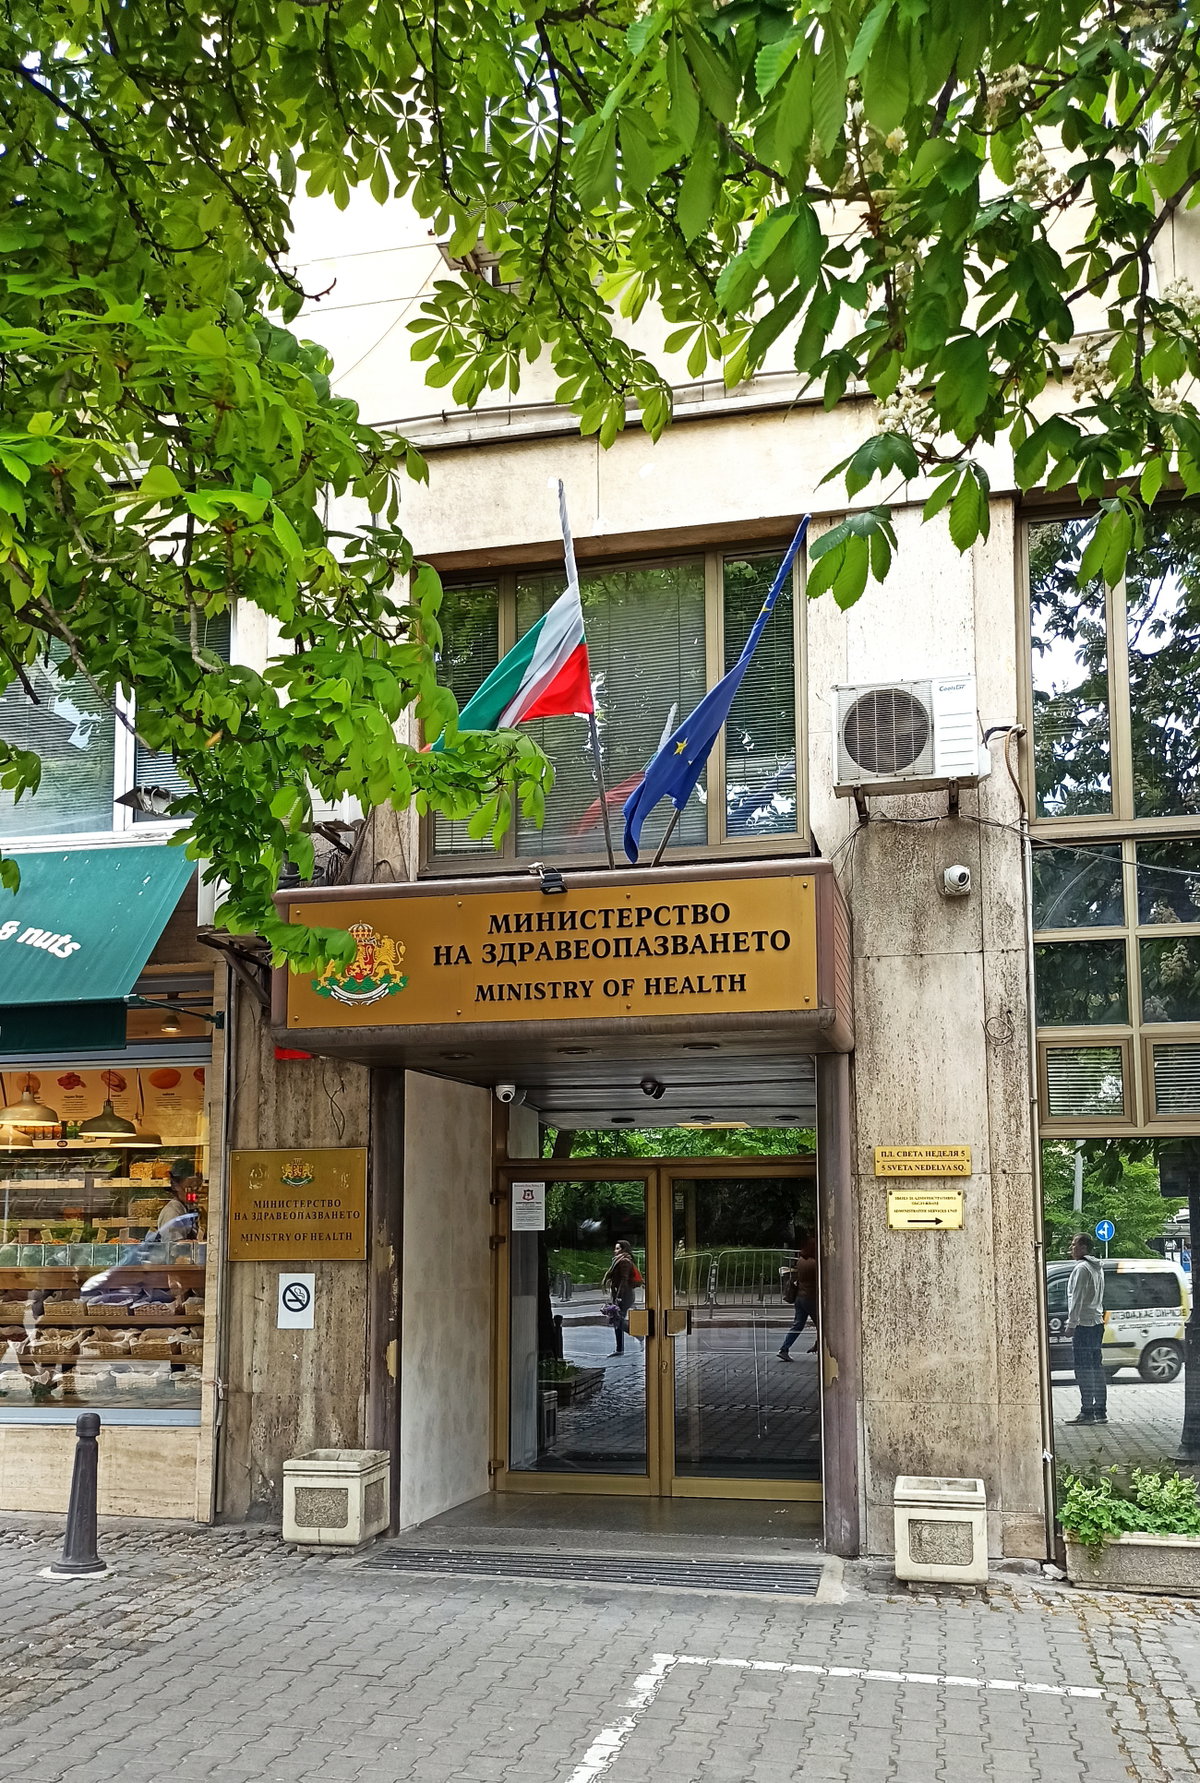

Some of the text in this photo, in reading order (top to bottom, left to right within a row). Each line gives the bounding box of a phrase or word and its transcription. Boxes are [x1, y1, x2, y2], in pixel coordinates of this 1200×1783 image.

[487, 902, 731, 935] МИНИСТЕРСТВО
[0, 920, 82, 959] & nuts
[433, 929, 791, 967] НА ЗДРАВЕОПАЗВАНЕТО
[474, 973, 747, 1002] MINISTRY OF HEALTH
[896, 1150, 923, 1158] СВЕТА
[925, 1150, 959, 1158] НЕДЕЛЯ
[953, 1164, 967, 1172] SQ.
[253, 1199, 342, 1209] МИНИСТЕРСТВО
[234, 1210, 361, 1222] НА ЗДРАВЕОПАЗВАНЕТО
[240, 1232, 353, 1242] MINISTRY OF HEALTH
